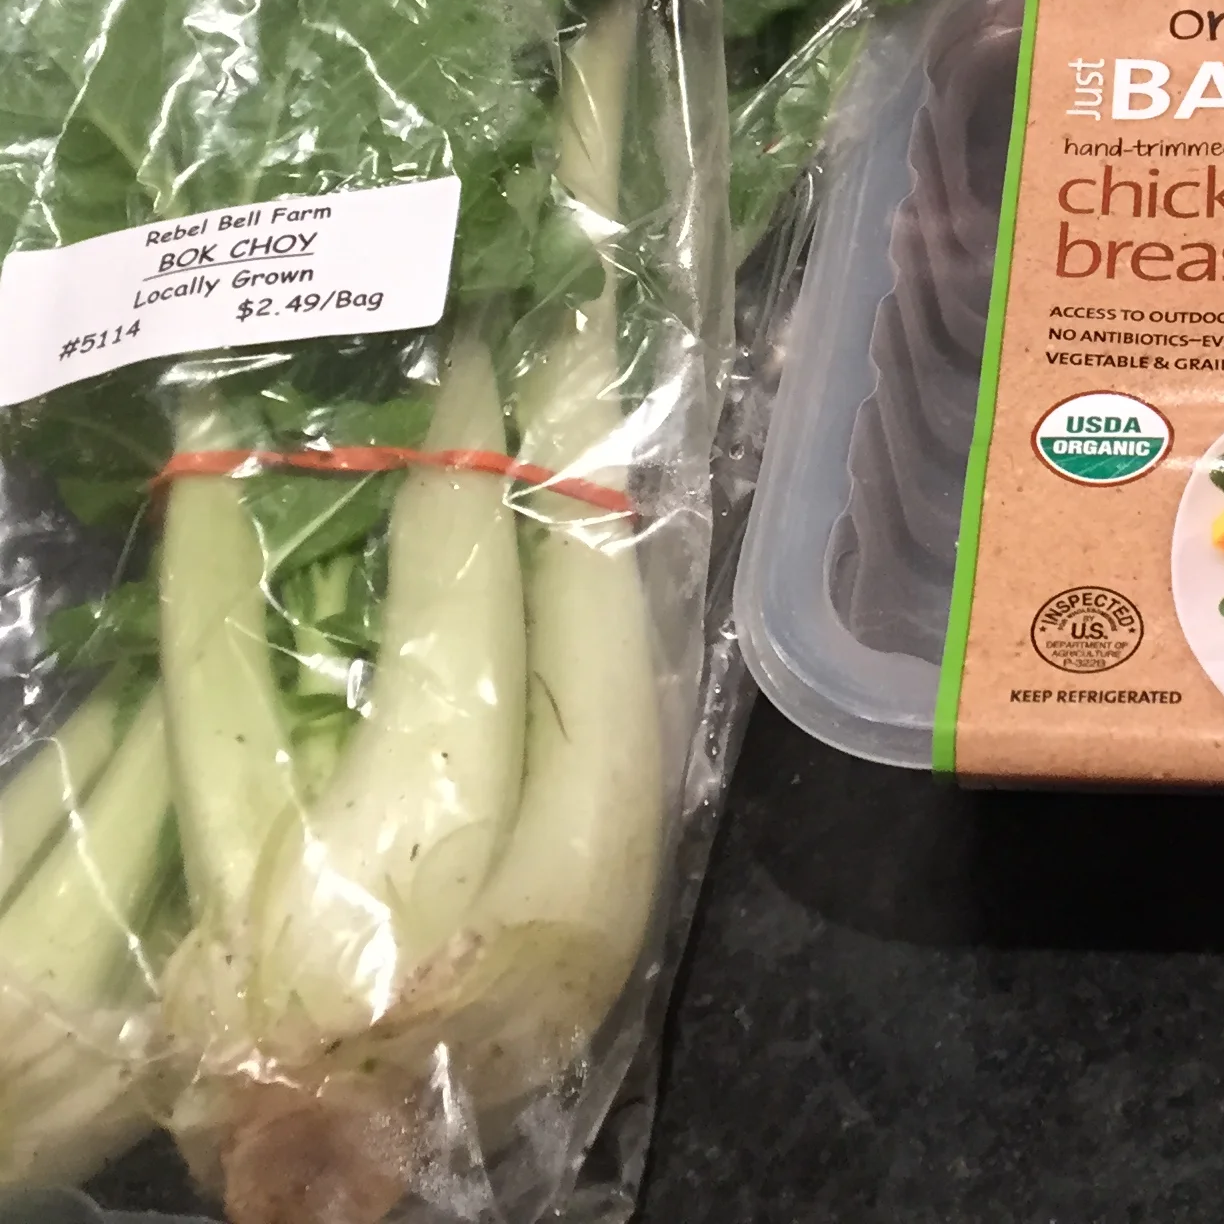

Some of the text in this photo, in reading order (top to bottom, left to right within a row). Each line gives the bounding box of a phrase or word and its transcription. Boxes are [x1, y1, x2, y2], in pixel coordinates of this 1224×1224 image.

[1065, 57, 1104, 121] Just
[145, 205, 333, 247] Rebel Bell Farm
[158, 232, 319, 274] BOK CHOY
[133, 266, 314, 310] Locally Grown
[235, 288, 385, 322] $2.49/Bag
[1050, 306, 1117, 321] ACCESS
[1121, 309, 1145, 322] TO
[59, 319, 142, 362] #5114
[1048, 328, 1077, 341] NO
[1045, 351, 1149, 369] VEGETABLE
[1153, 356, 1169, 370] &
[1065, 415, 1142, 434] USDA
[1053, 439, 1151, 457] ORGANIC
[1041, 592, 1135, 627] INSPECTED
[1071, 622, 1108, 640] U.S.
[1046, 640, 1112, 649] DEPARTMENT
[1010, 690, 1182, 705] KEEP REFRIGERATED
